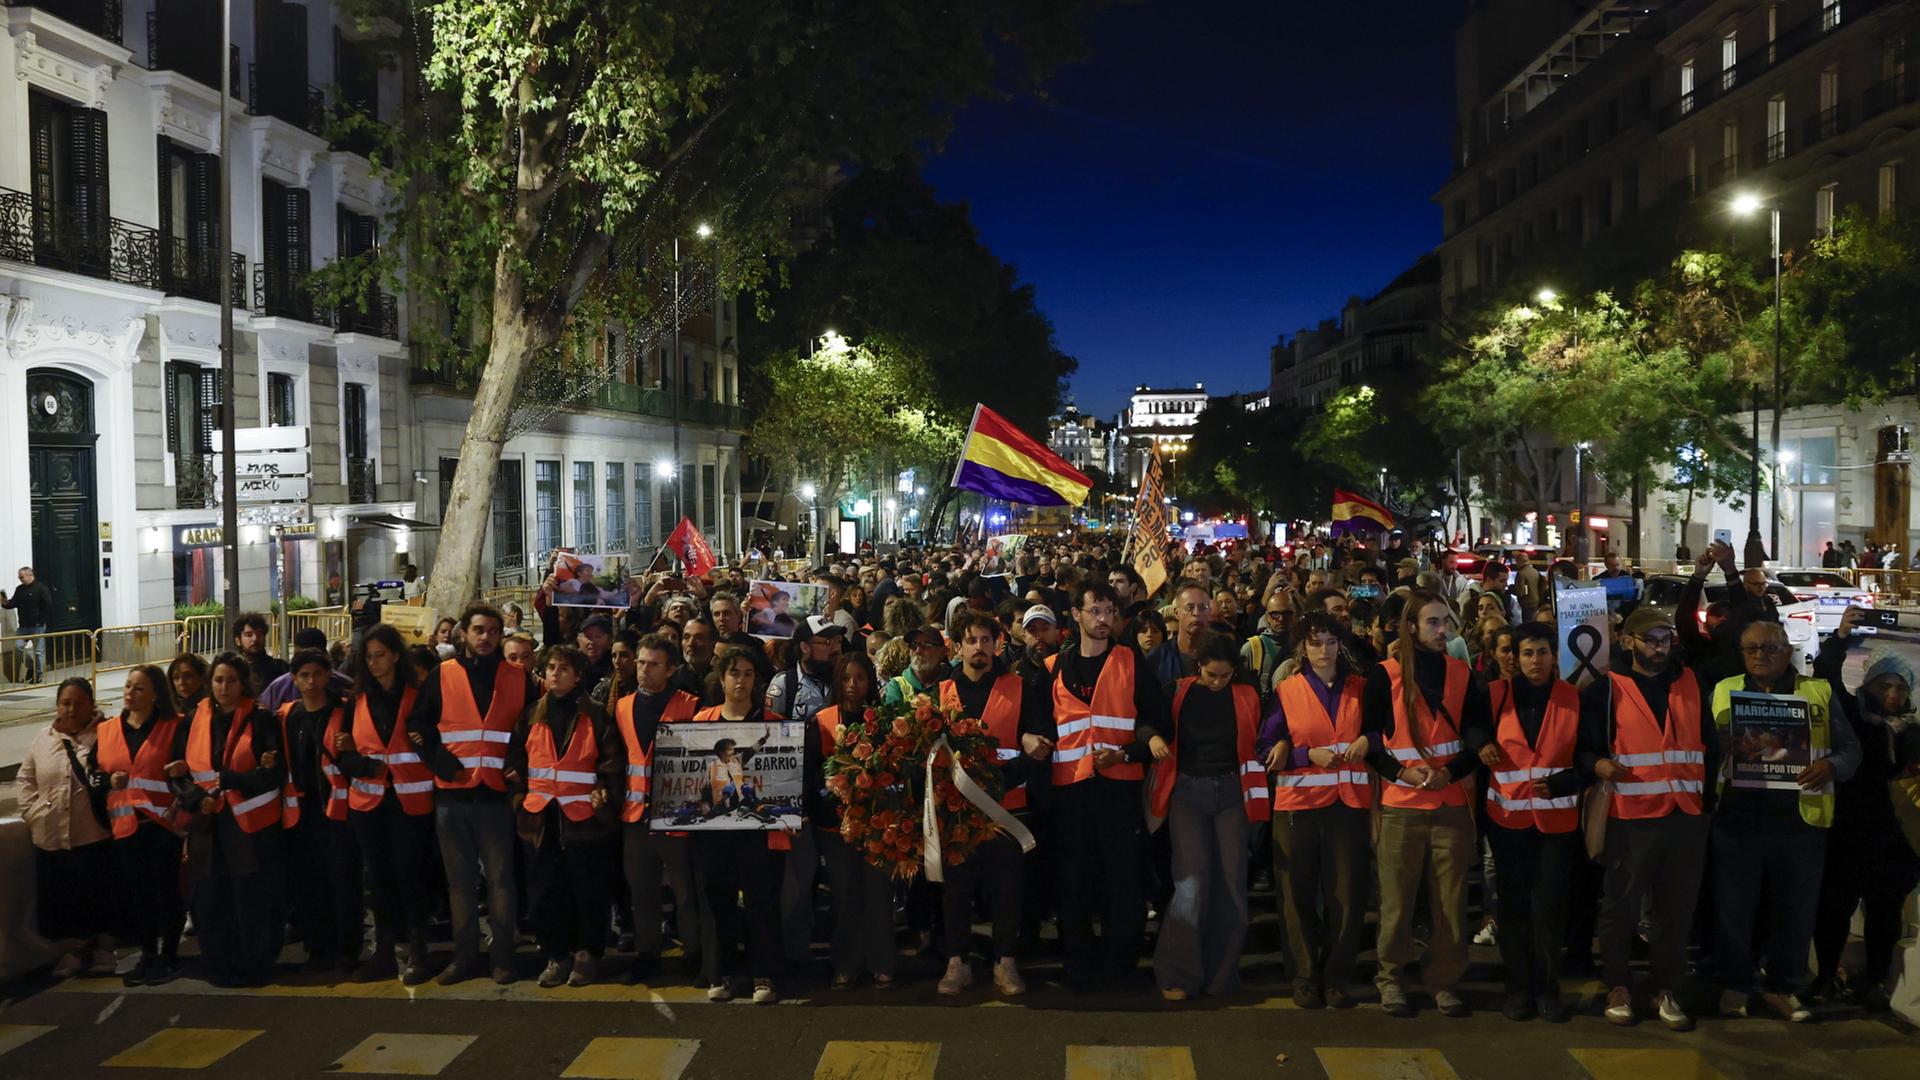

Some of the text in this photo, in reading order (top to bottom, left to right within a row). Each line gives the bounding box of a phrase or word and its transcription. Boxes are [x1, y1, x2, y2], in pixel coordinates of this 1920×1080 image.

[1580, 602, 1594, 610] UNA
[1560, 607, 1606, 619] MARICARMEN
[1735, 704, 1805, 719] MARICARMEN
[682, 759, 707, 773] VIDA
[755, 757, 797, 771] BARRIO
[1770, 764, 1785, 774] POR
